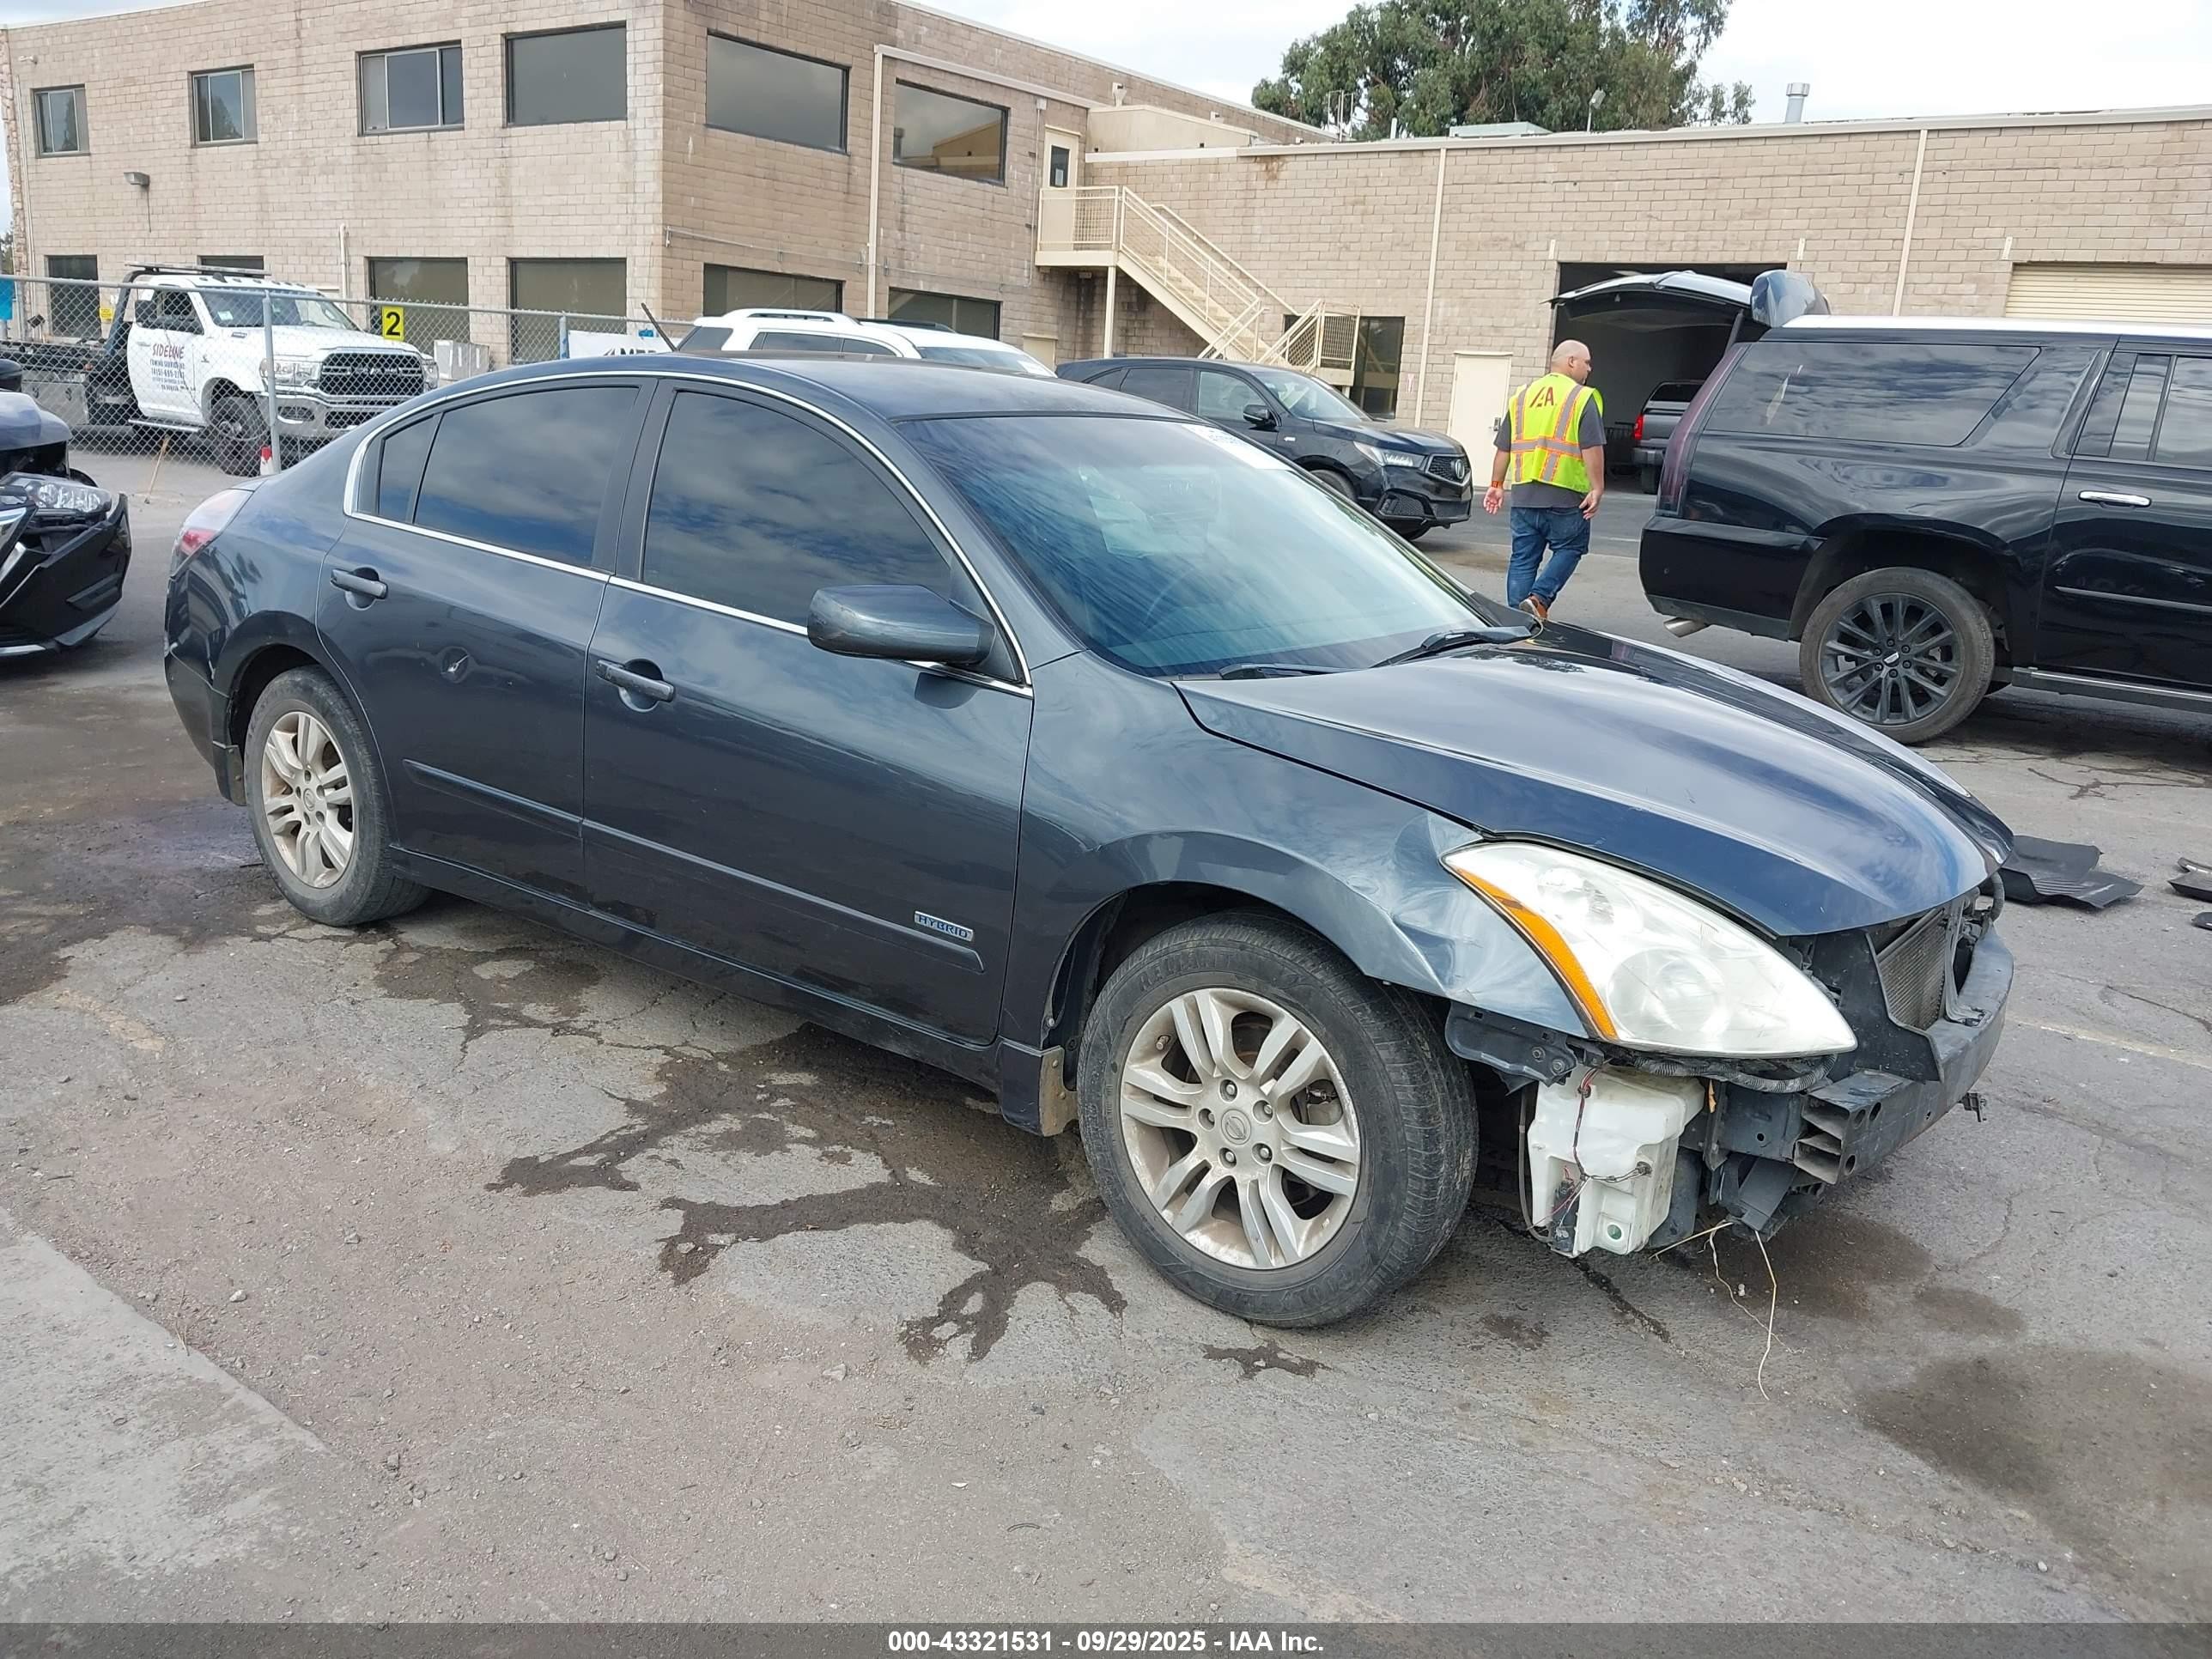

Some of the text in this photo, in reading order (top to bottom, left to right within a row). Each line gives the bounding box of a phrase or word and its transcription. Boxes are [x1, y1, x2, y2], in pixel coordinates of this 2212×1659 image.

[386, 311, 401, 336] 2
[152, 343, 185, 360] SIDELINE
[918, 915, 969, 938] HYBRID
